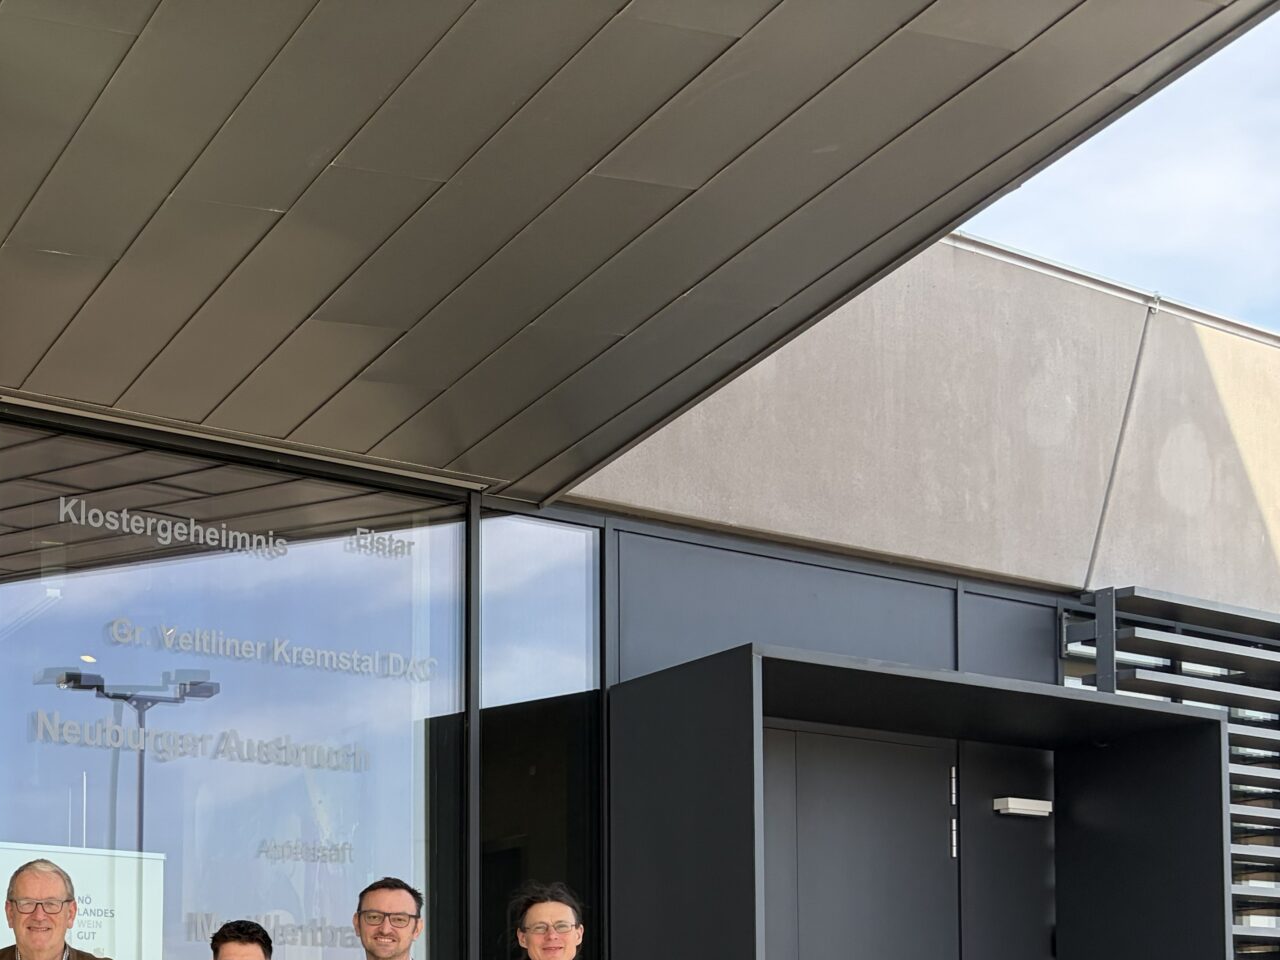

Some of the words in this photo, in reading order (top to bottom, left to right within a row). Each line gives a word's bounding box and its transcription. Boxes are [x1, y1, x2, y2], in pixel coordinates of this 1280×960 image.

[59, 496, 288, 557] Klostergeheimnis
[356, 527, 415, 556] Elstar
[161, 624, 265, 660] Veltliner
[273, 638, 379, 674] Kremstal
[387, 653, 438, 681] DAC
[35, 708, 212, 761] Neuburger
[218, 729, 371, 772] Ausbruch
[77, 895, 92, 905] NÖ
[77, 908, 115, 918] LANDES
[77, 920, 102, 928] WEIN
[77, 931, 96, 940] GUT
